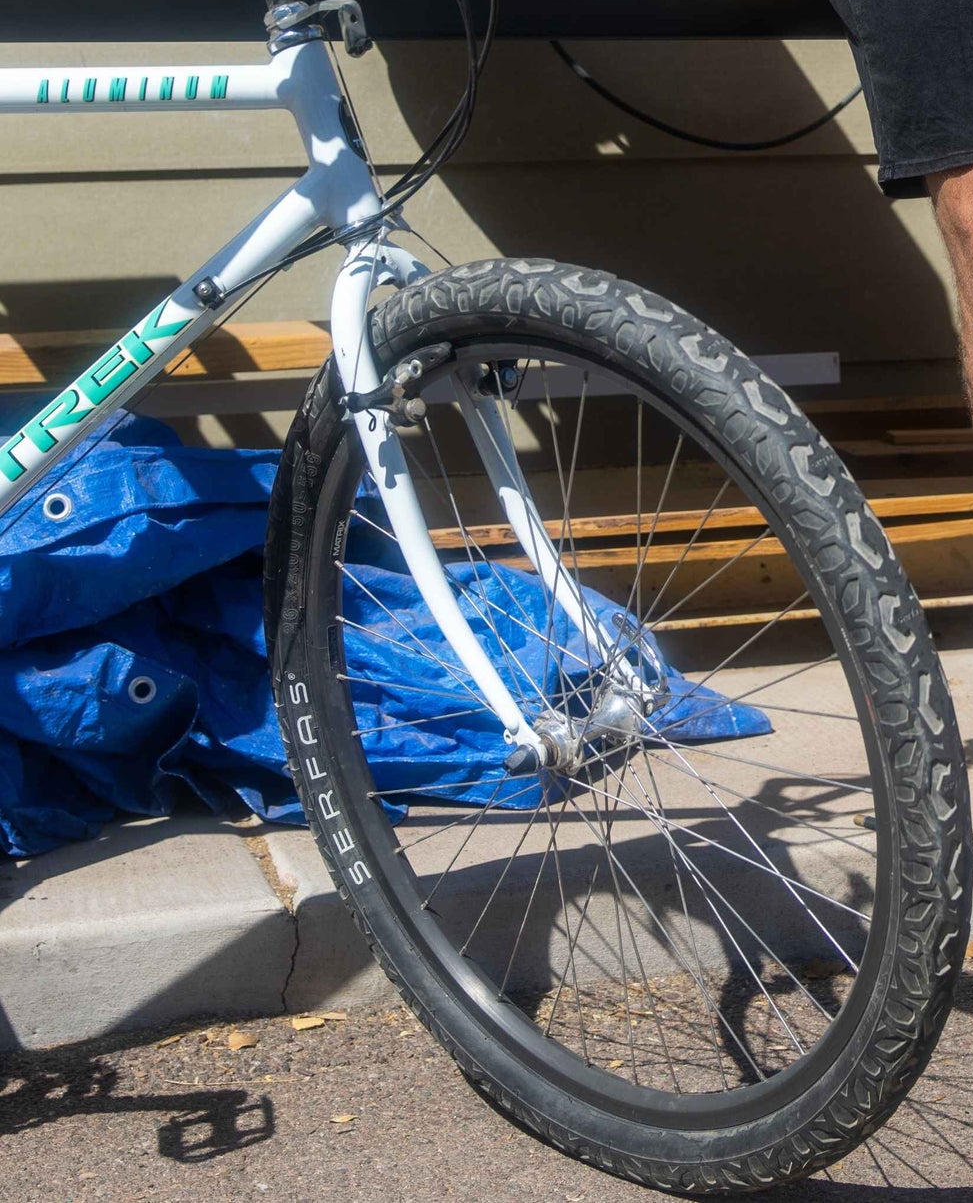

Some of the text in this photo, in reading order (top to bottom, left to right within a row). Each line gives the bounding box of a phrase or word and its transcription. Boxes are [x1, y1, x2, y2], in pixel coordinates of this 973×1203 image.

[36, 75, 229, 103] ALUMINUM
[0, 296, 194, 482] TREK
[332, 520, 346, 557] MATRIX
